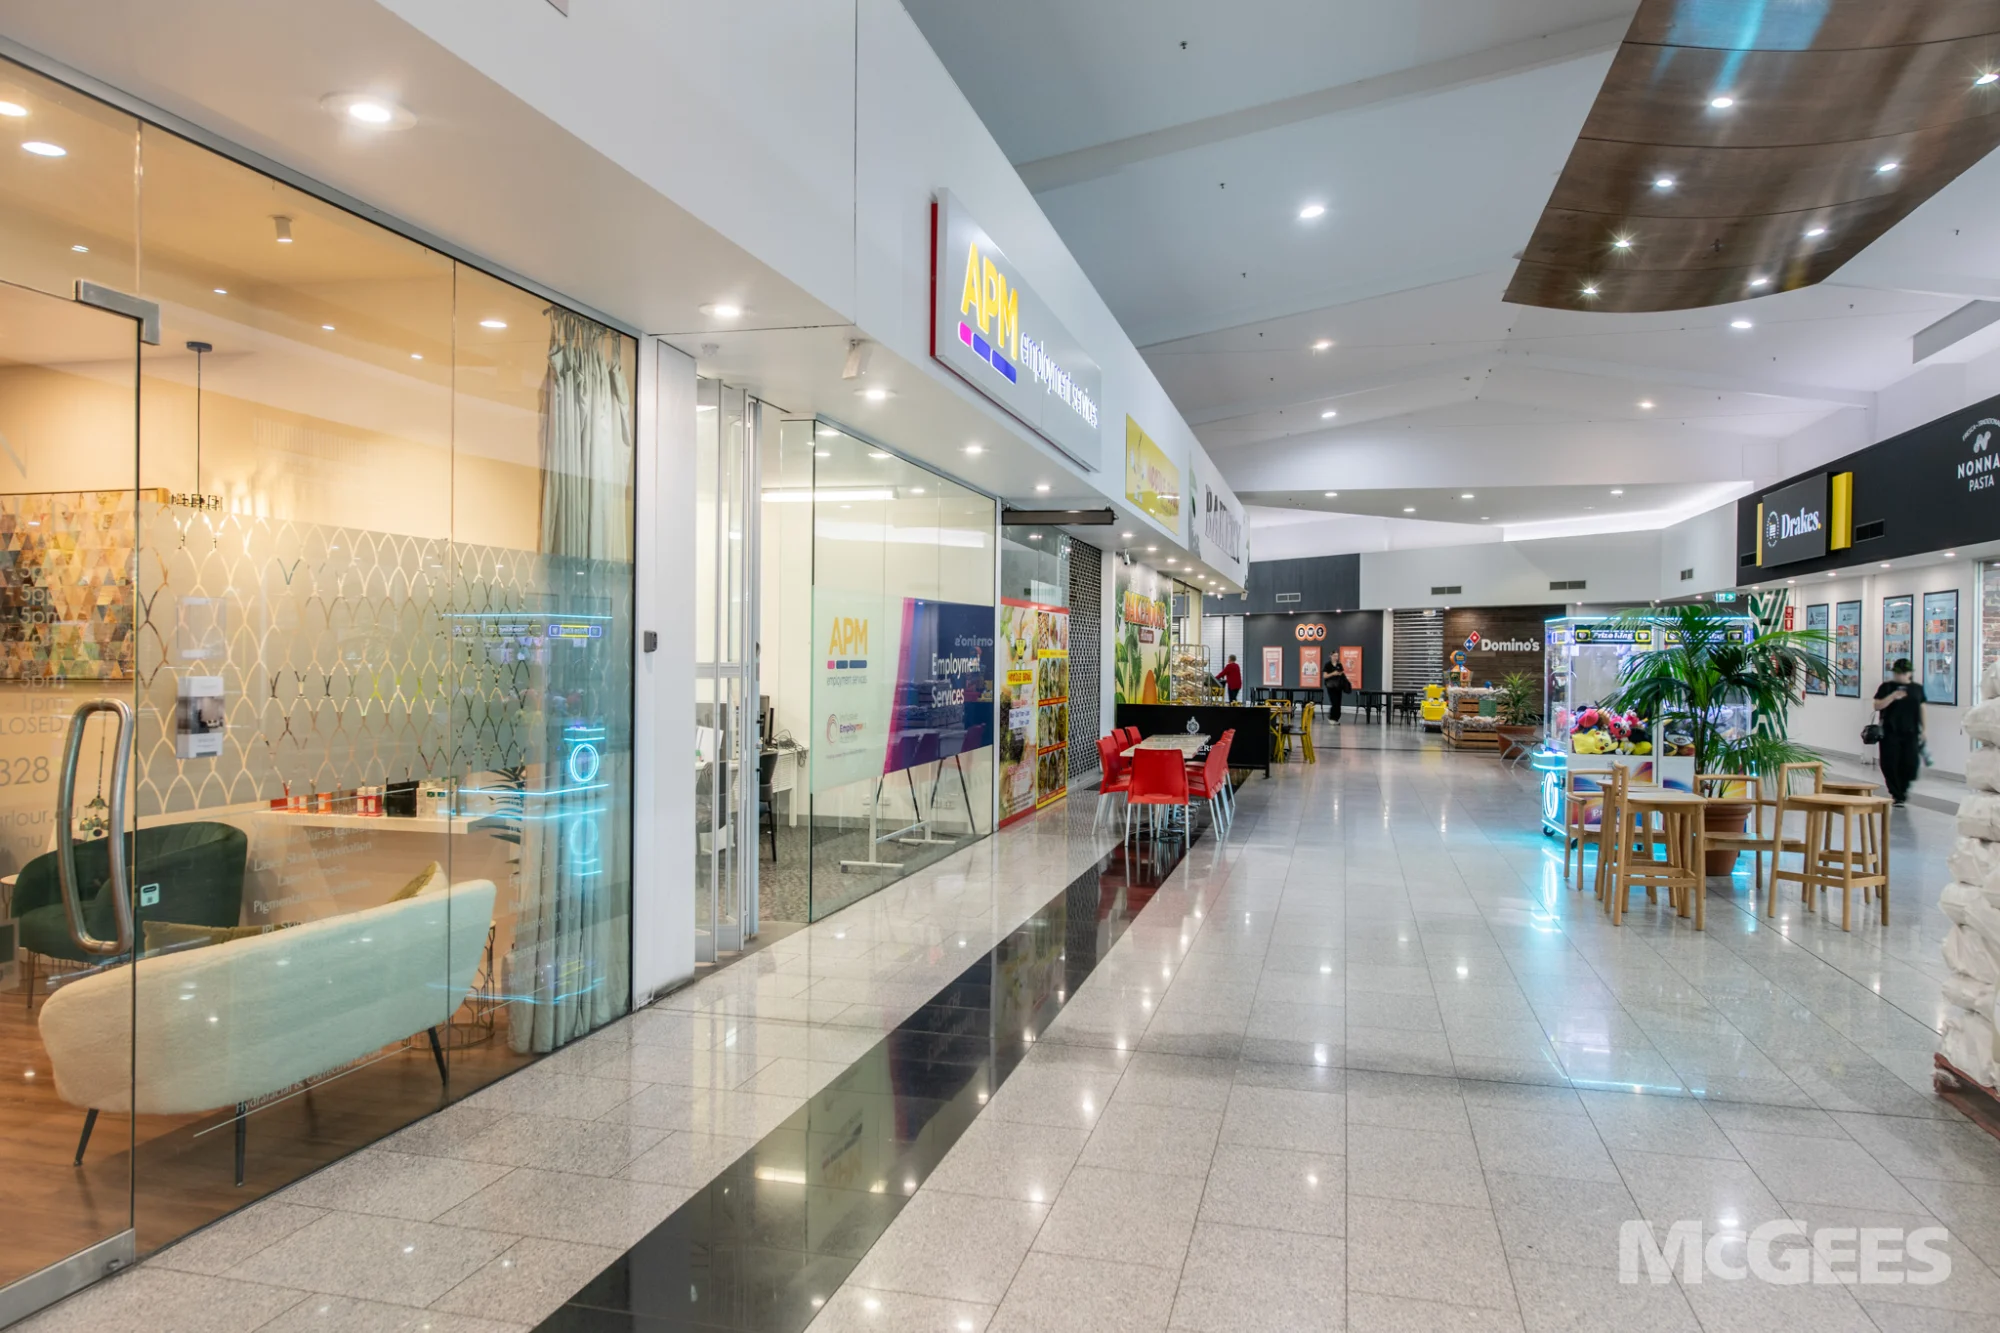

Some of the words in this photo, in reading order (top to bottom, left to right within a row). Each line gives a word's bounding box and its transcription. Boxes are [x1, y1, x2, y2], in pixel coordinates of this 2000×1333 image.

[960, 241, 1018, 361] APM
[1020, 332, 1072, 406] employment
[1071, 382, 1099, 429] services
[1969, 474, 1994, 492] PASTA
[828, 617, 868, 656] APM
[1481, 638, 1540, 652] Domino's
[932, 652, 981, 679] Employment
[931, 685, 965, 709] Services
[0, 756, 50, 787] 328
